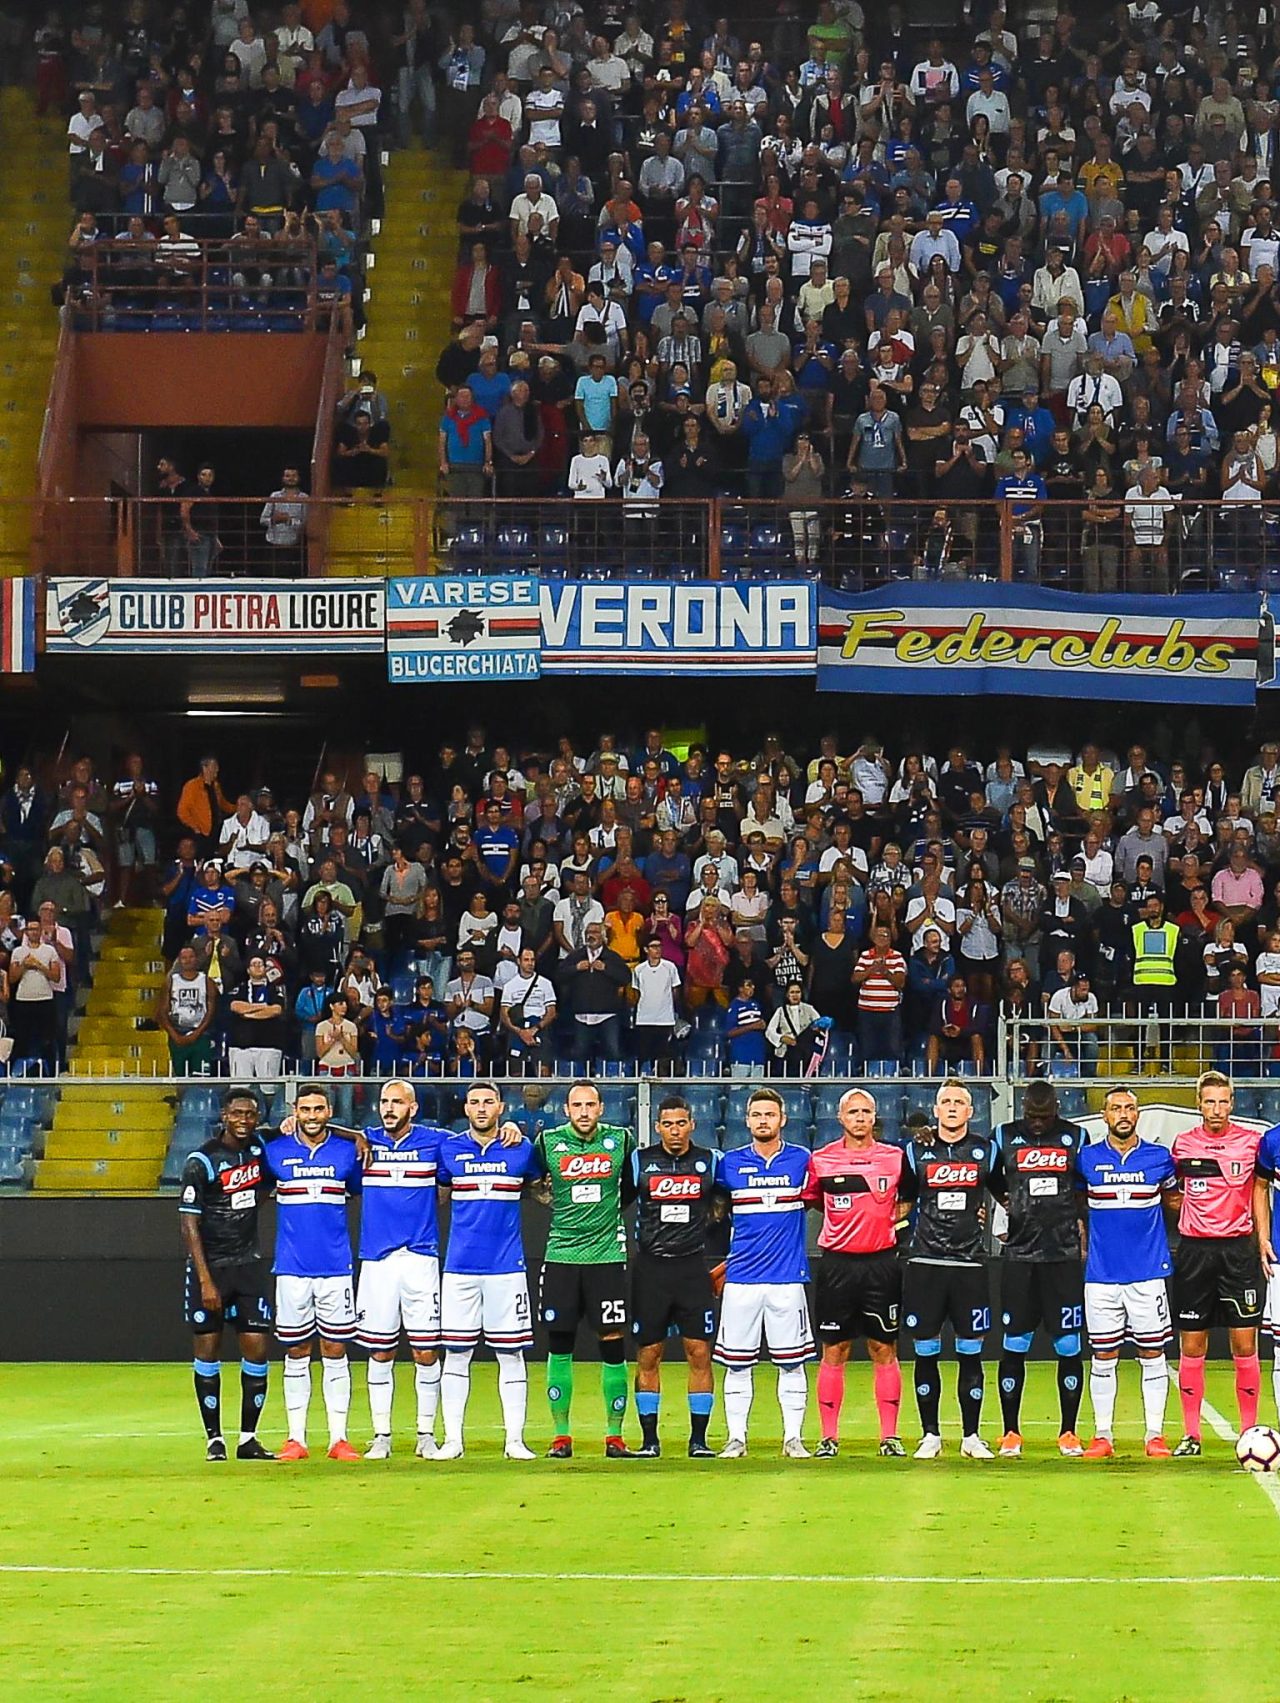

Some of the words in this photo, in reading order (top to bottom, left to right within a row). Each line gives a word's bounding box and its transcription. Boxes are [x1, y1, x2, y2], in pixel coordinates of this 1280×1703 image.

[396, 580, 532, 606] VARESE
[119, 593, 185, 630] CLUB
[193, 593, 281, 630] PIETRA
[288, 592, 379, 630] LIGURE
[540, 584, 810, 648] VERONA
[840, 609, 1238, 674] Federclubs
[391, 653, 539, 677] BLUCERCHIATA
[377, 1149, 419, 1161] Invent
[1017, 1149, 1068, 1168] Lete
[224, 1163, 260, 1191] Lete
[292, 1165, 335, 1178] Invent
[464, 1161, 507, 1174] Invent
[561, 1157, 611, 1177] Lete
[927, 1165, 978, 1184] Lete
[1102, 1170, 1145, 1183] Invent
[650, 1178, 701, 1197] Lete
[748, 1174, 791, 1187] Invent
[601, 1299, 626, 1324] 25
[704, 1310, 713, 1334] 5
[1061, 1304, 1082, 1329] 26
